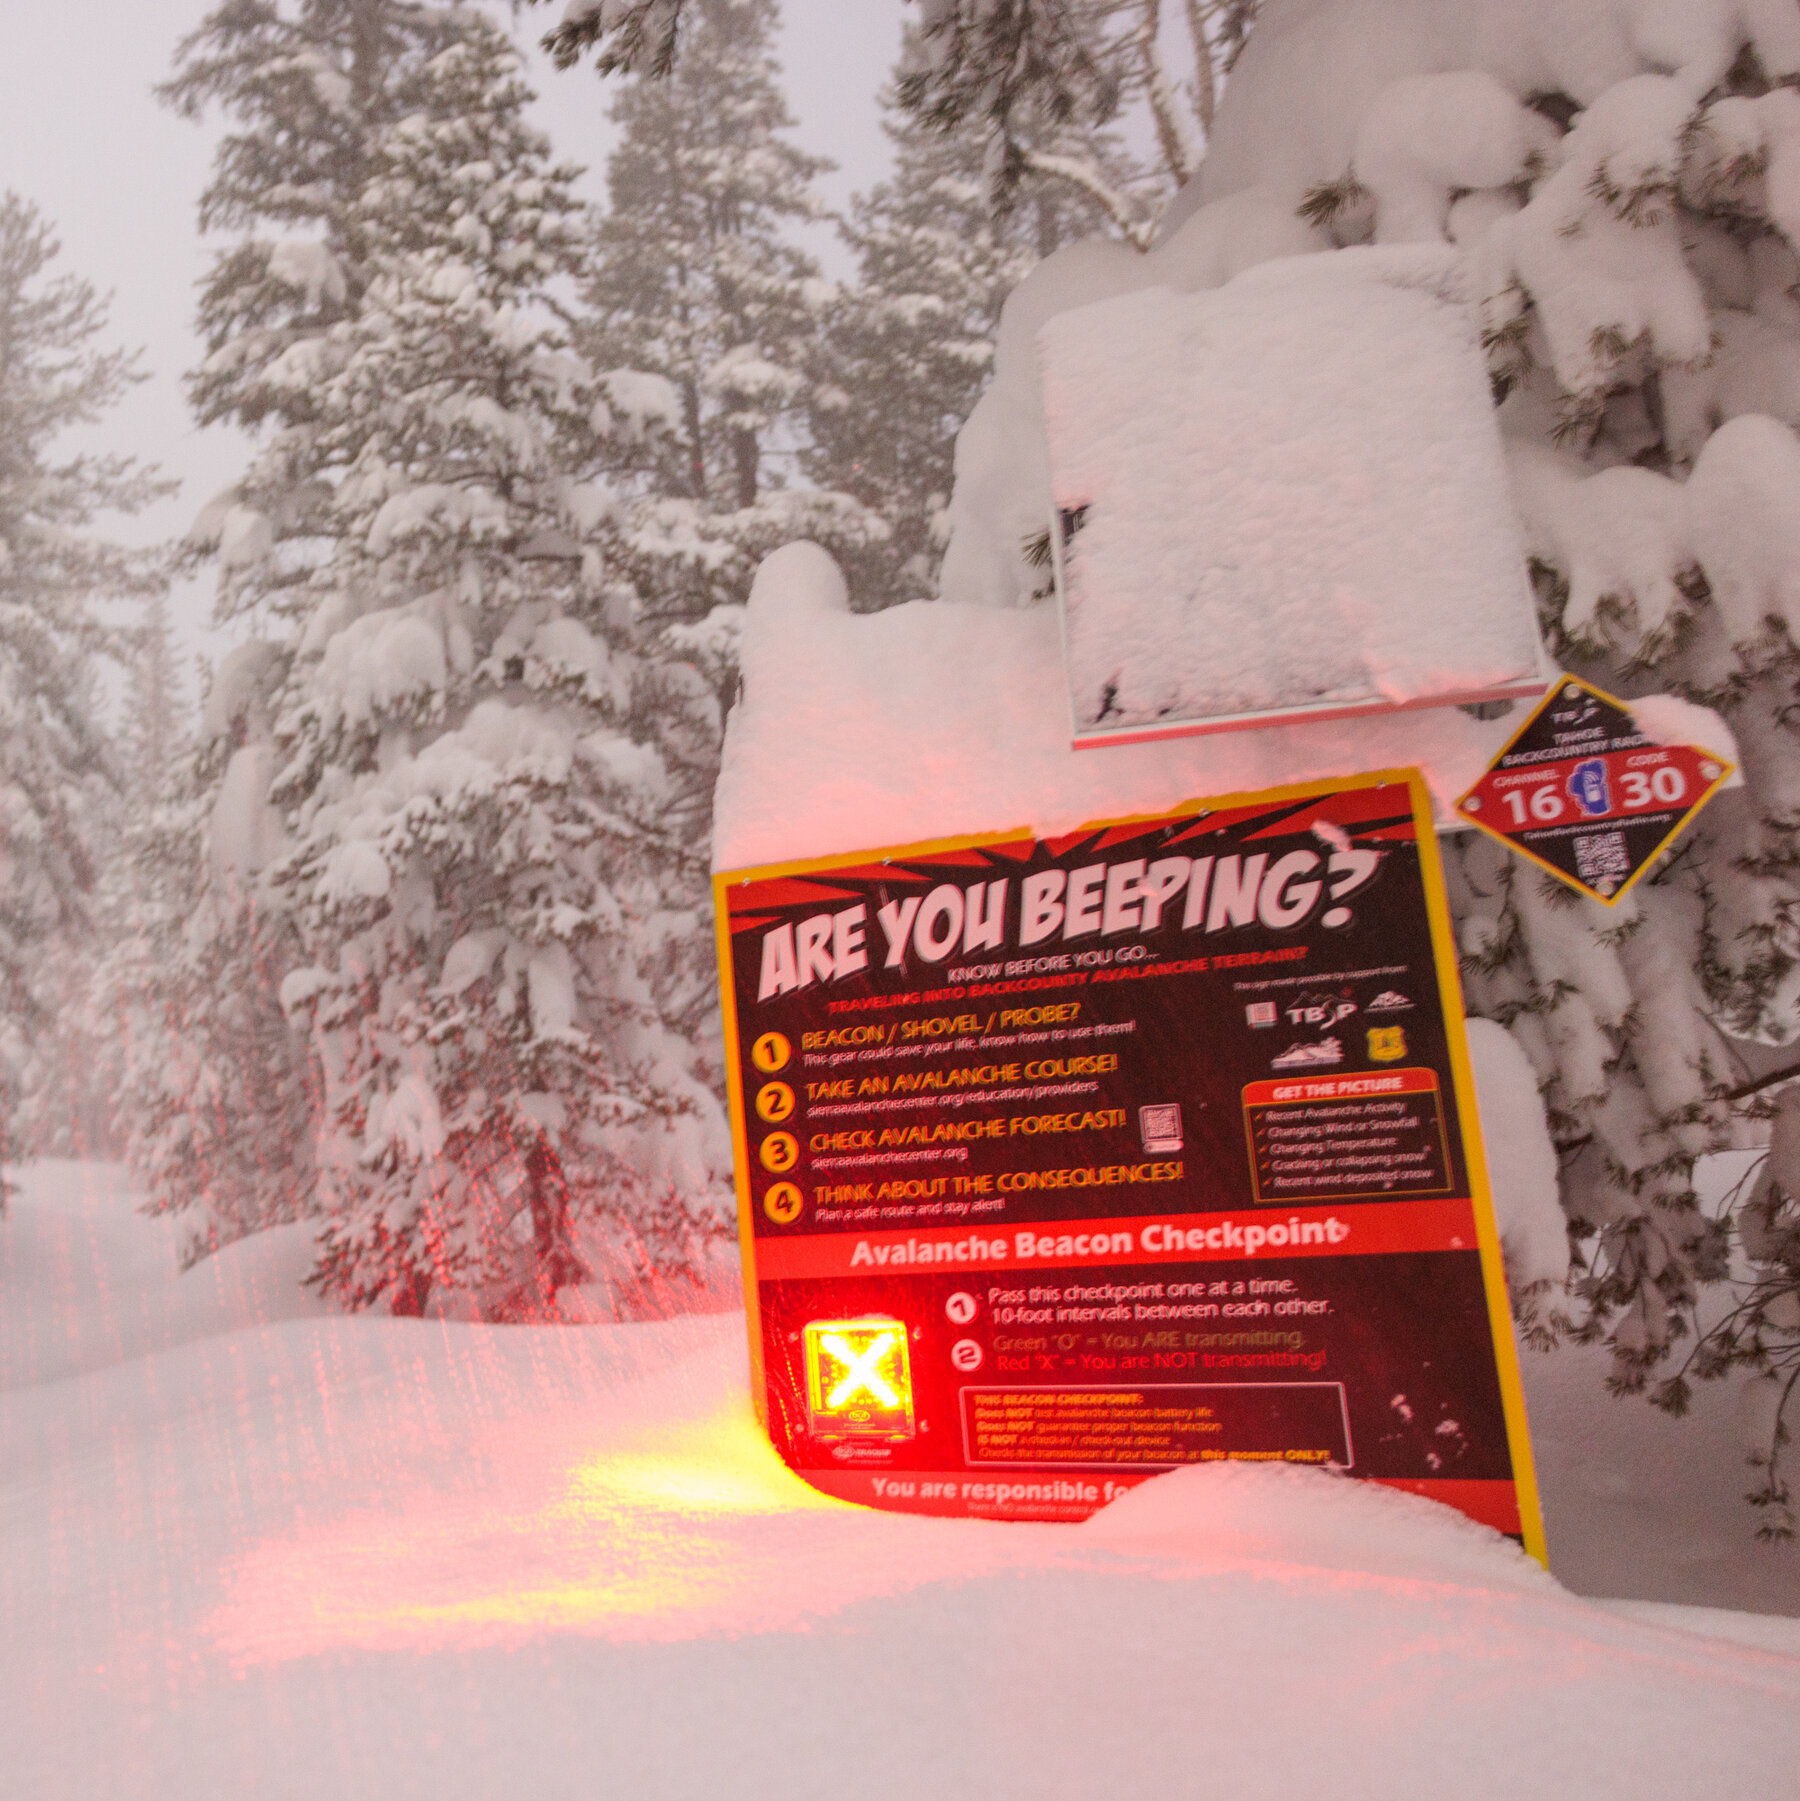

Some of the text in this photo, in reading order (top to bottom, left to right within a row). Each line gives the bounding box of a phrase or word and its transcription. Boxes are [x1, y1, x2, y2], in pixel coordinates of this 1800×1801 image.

[1552, 726, 1607, 745] TAHOE
[1502, 734, 1645, 767] BACKCOUNTRY RAD
[1627, 751, 1669, 767] CODE
[1492, 769, 1561, 788] CHANNEL
[1619, 767, 1686, 808] 30
[1501, 784, 1564, 825] 16
[757, 848, 1381, 1003] ARE YOU BEEPING?
[948, 945, 1160, 983] KNOW BEFORE YOU GO...
[828, 991, 921, 1015] TRAVELING
[922, 985, 966, 1004] INTO
[1091, 957, 1209, 983] AVALANCHE
[1211, 946, 1309, 969] TERRAIN?
[802, 1002, 1082, 1050] BEACON / SHOVEL / PROBE?
[803, 1052, 828, 1067] This
[828, 1050, 858, 1066] gear
[858, 1044, 894, 1062] could
[894, 1044, 923, 1057] save
[924, 1040, 954, 1058] your
[978, 1033, 1018, 1047] know
[1018, 1030, 1051, 1044] how
[1051, 1029, 1068, 1042] to
[1068, 1026, 1093, 1041] use
[1094, 1020, 1136, 1036] them!
[806, 1053, 1118, 1101] TAKE AN AVALANCHE COURSE!
[1272, 1076, 1404, 1100] GET THE PICTURE
[1265, 1102, 1408, 1122] Recent Avalanche Activity
[810, 1109, 1127, 1152] CHECK AVALANCHE FORECAST!
[1267, 1116, 1420, 1139] Changing Wind or Snowfall
[811, 1146, 968, 1169] sierraavalanchecenter.org
[1269, 1137, 1399, 1155] Changing Temperature
[1271, 1152, 1428, 1172] Cracking or collapsing snow
[815, 1161, 1184, 1204] THINK ABOUT THE CONSEQUENCES!
[1273, 1170, 1435, 1188] Recent wind deposited snow
[815, 1197, 1006, 1222] Plan a safe route and stay alert!
[850, 1216, 1342, 1267] Avalanche Beacon Checkpoint
[988, 1277, 1299, 1304] Pass this checkpoint one at a time.
[993, 1297, 1335, 1325] 10-foot intervals between each other.
[993, 1335, 1048, 1351] Green
[1102, 1333, 1138, 1349] You
[1142, 1330, 1181, 1348] ARE
[997, 1355, 1030, 1371] Red
[1081, 1354, 1116, 1369] You
[1121, 1356, 1150, 1369] are
[1154, 1351, 1198, 1369] NOT
[1203, 1349, 1327, 1371] transmitting!
[975, 1394, 1002, 1406] THIS
[1003, 1394, 1056, 1406] BEACON
[975, 1408, 1005, 1419] Does
[1005, 1407, 1034, 1419] NOT
[1055, 1407, 1111, 1418] avalanche
[1111, 1407, 1153, 1418] beacon
[1154, 1407, 1194, 1420] battery
[1195, 1406, 1214, 1418] life
[976, 1420, 1223, 1434] Does NOT guarantee proper beacon function
[990, 1434, 1018, 1445] NOT
[1134, 1435, 1172, 1446] device
[1017, 1448, 1035, 1458] the
[1035, 1448, 1102, 1459] transmission
[1102, 1447, 1115, 1458] of
[1115, 1450, 1142, 1462] your
[1142, 1449, 1186, 1460] beacon
[1187, 1450, 1199, 1459] at
[1200, 1449, 1227, 1460] this
[1228, 1450, 1284, 1461] moment
[1285, 1449, 1331, 1461] ONLY!
[871, 1477, 1130, 1504] You are responsible fo
